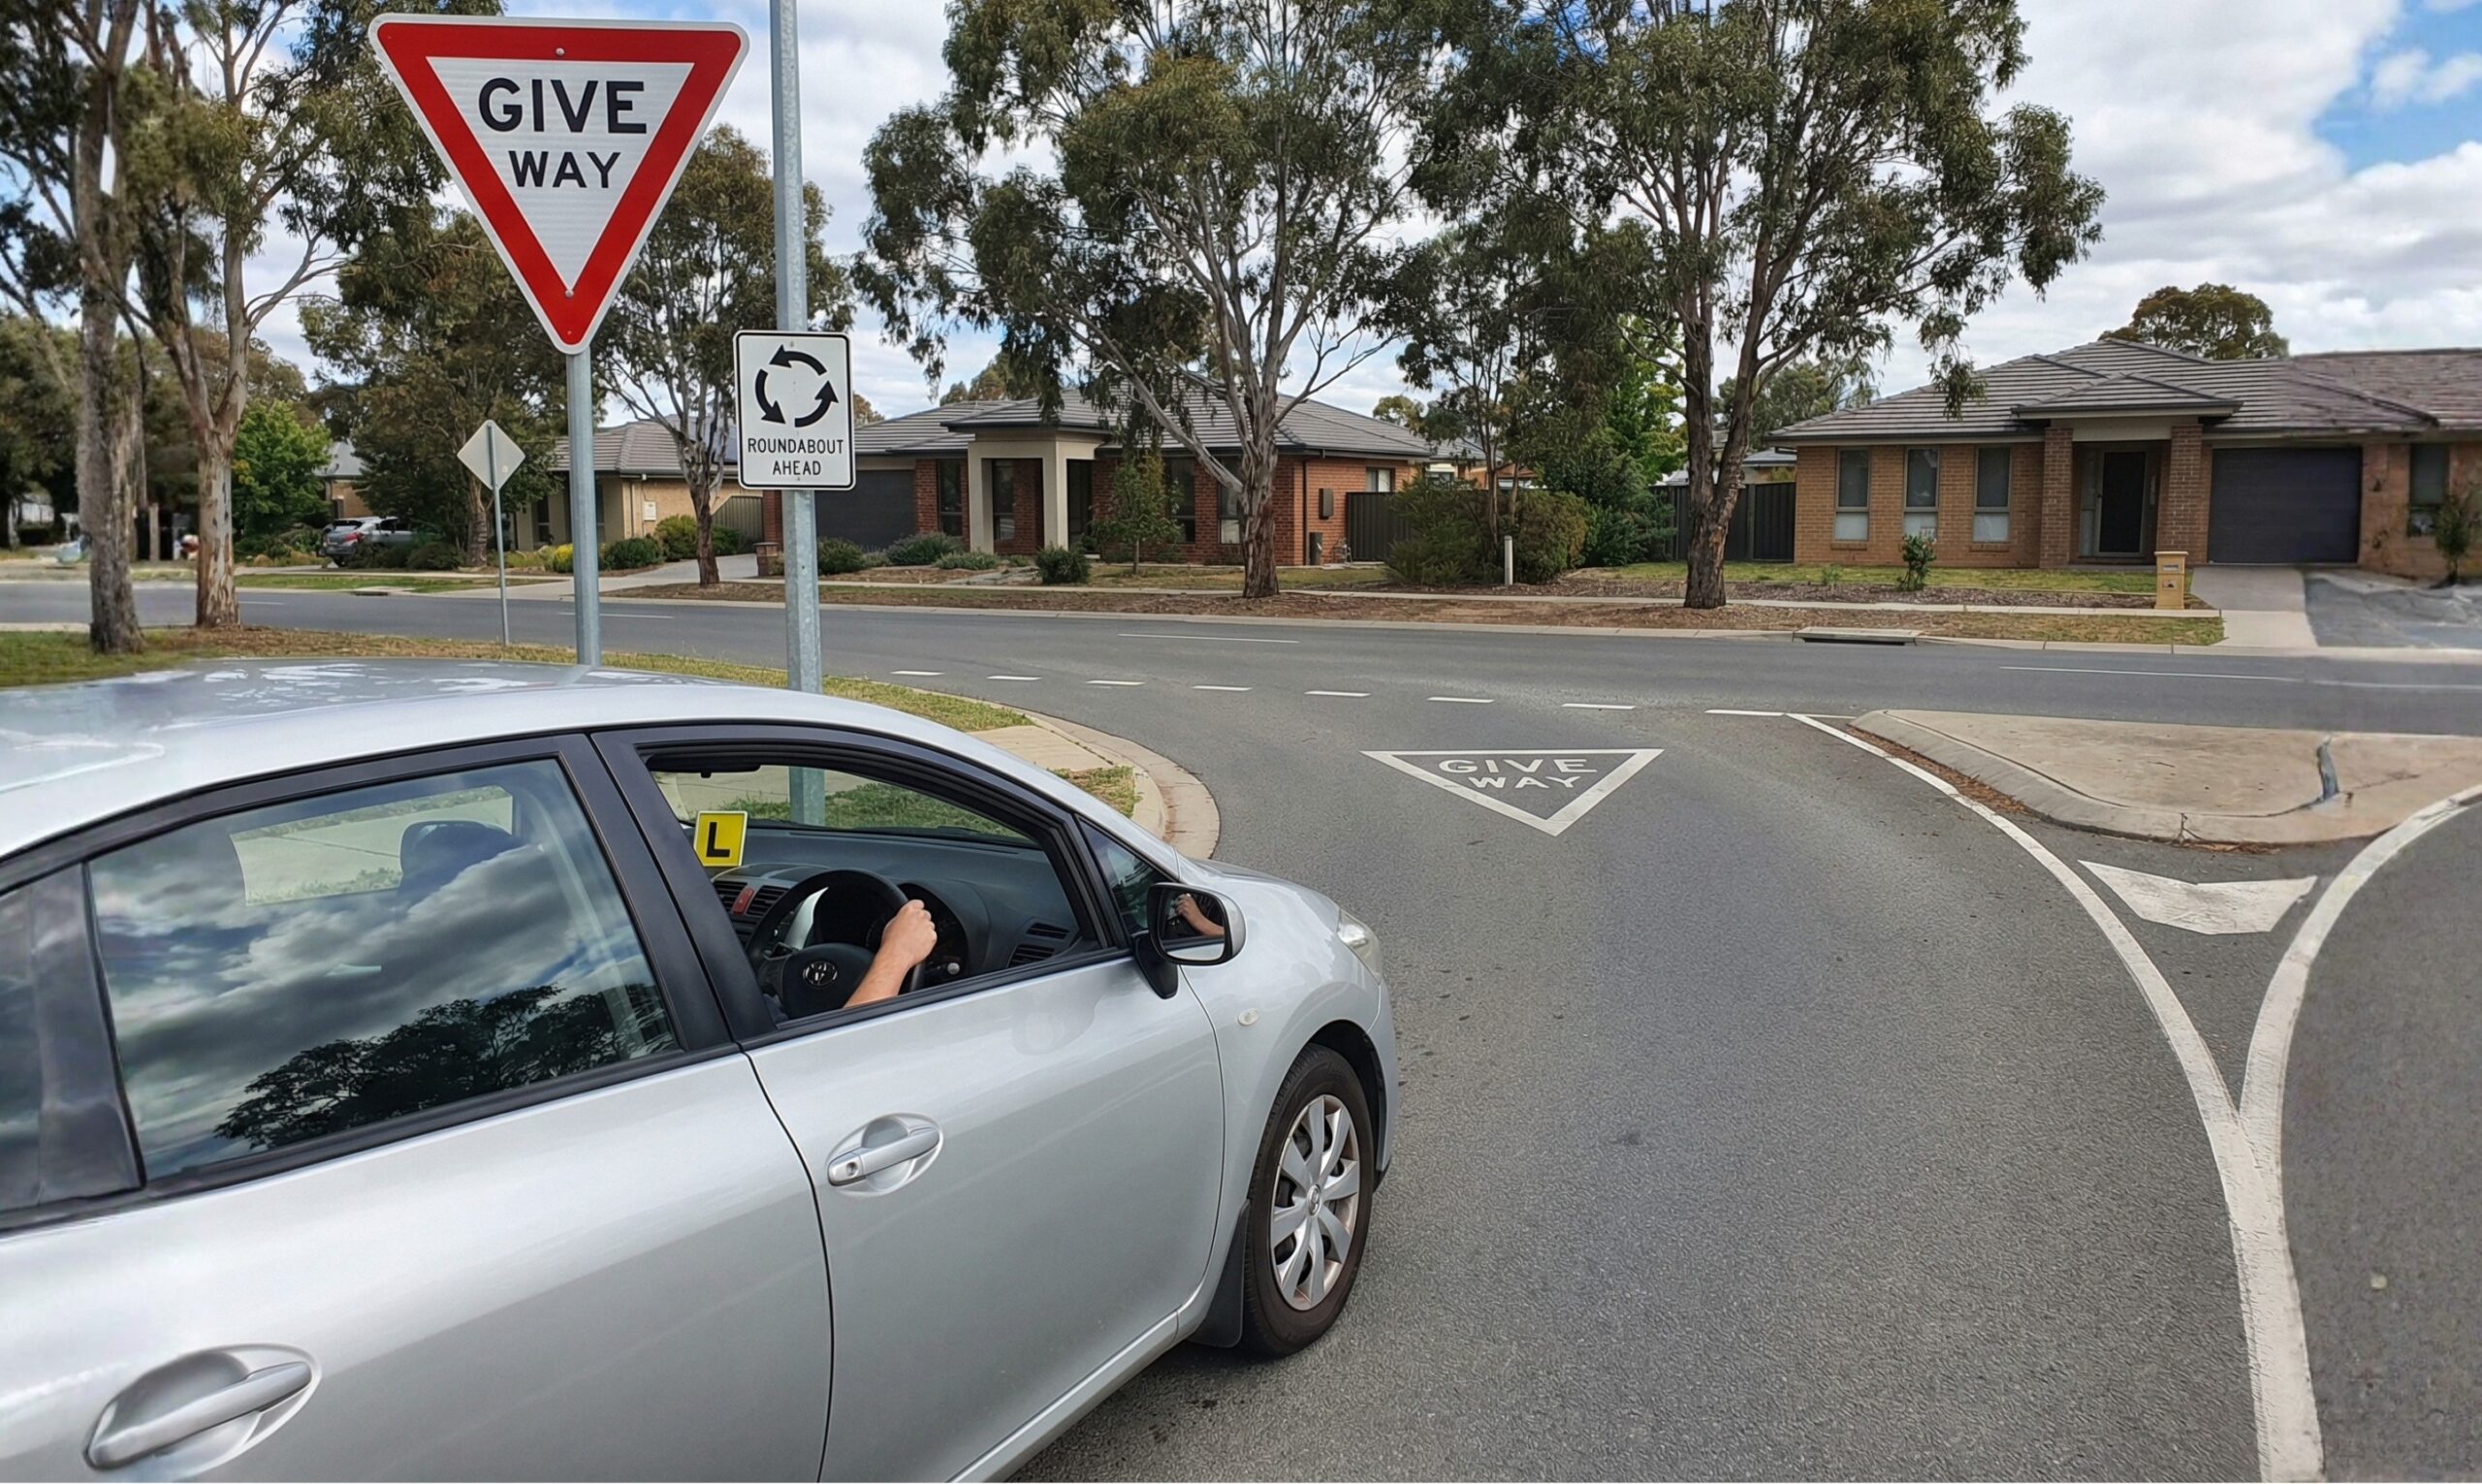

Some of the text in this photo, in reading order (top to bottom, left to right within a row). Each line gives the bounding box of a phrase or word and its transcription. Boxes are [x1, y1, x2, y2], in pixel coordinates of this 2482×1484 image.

[478, 78, 648, 134] GIVE
[509, 151, 620, 188] WAY
[748, 438, 844, 455] ROUNDABOUT
[772, 460, 822, 476] AHEAD
[1439, 759, 1599, 774] GIVE
[1468, 776, 1582, 788] WAY
[705, 821, 731, 858] L
